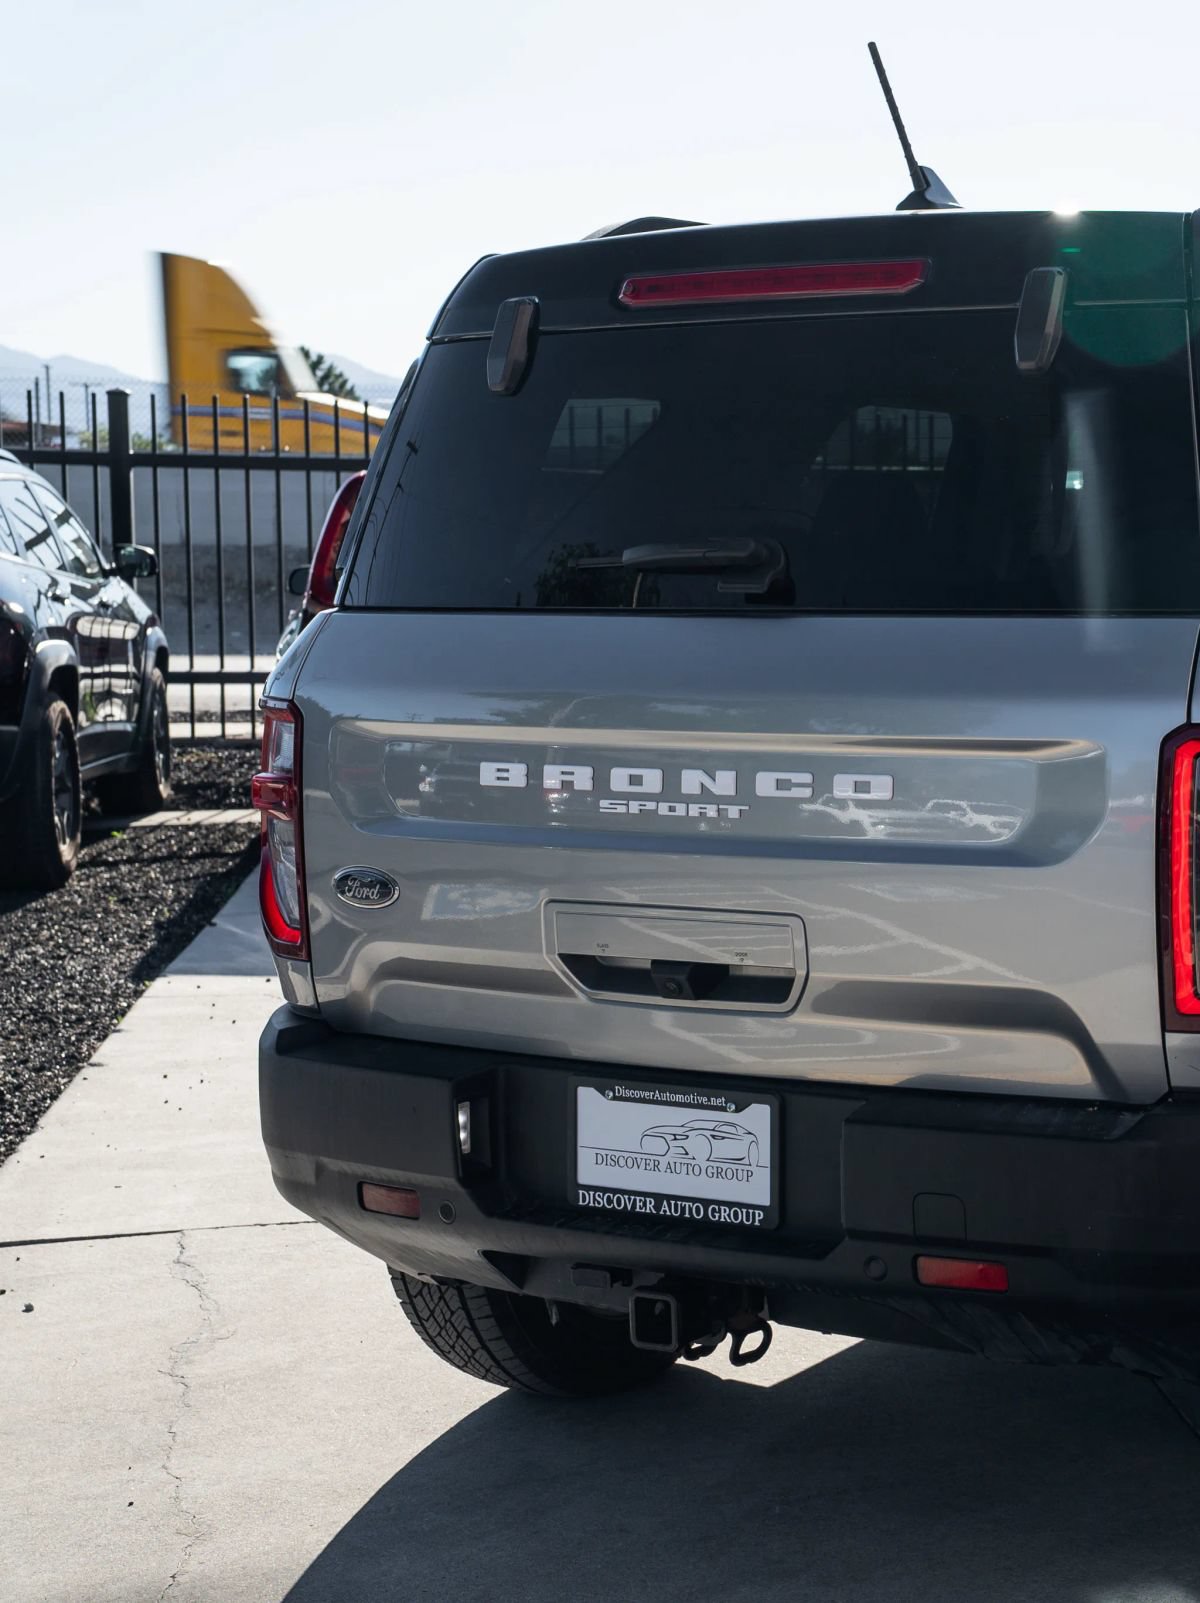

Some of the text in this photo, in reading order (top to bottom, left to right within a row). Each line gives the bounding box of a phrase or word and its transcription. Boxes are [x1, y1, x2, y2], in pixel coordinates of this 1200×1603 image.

[479, 761, 894, 800] BRONCO
[599, 800, 750, 819] SPORT
[345, 875, 380, 900] Ford
[615, 1086, 726, 1107] DiscoverAutomotive.net
[594, 1152, 754, 1183] DISCOVER AUTO GROUP
[577, 1190, 764, 1226] DISCOVER AUTO GROUP
